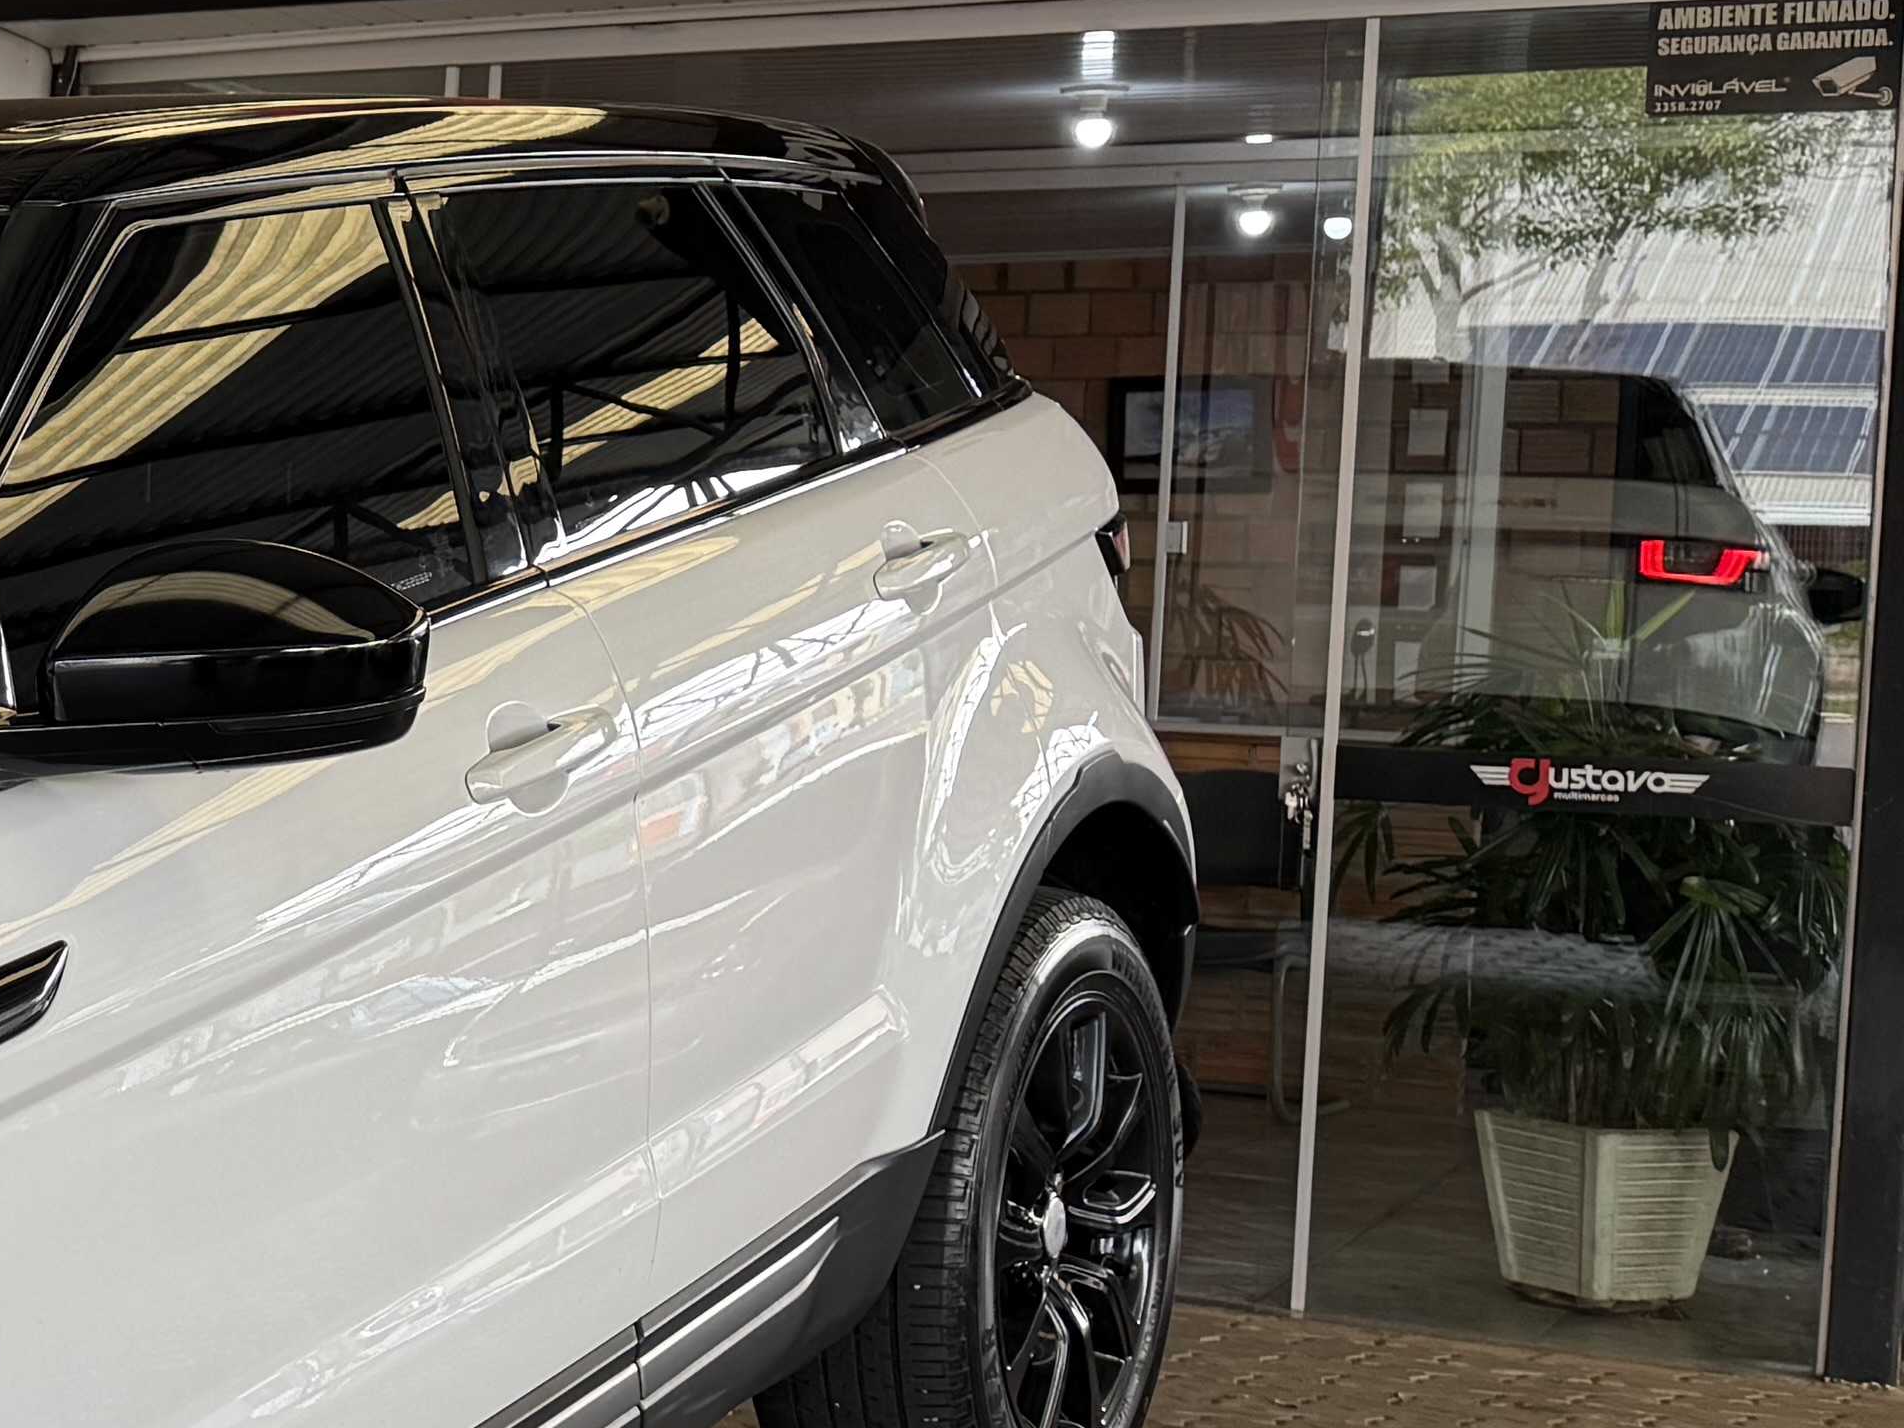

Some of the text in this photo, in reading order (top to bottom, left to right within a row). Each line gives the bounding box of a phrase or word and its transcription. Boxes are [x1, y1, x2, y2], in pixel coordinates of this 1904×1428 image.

[1657, 3, 1778, 30] AMBIENTE
[1657, 28, 1894, 56] SEGURANÇA GARANTIDA.
[1508, 758, 1672, 807] gustavo
